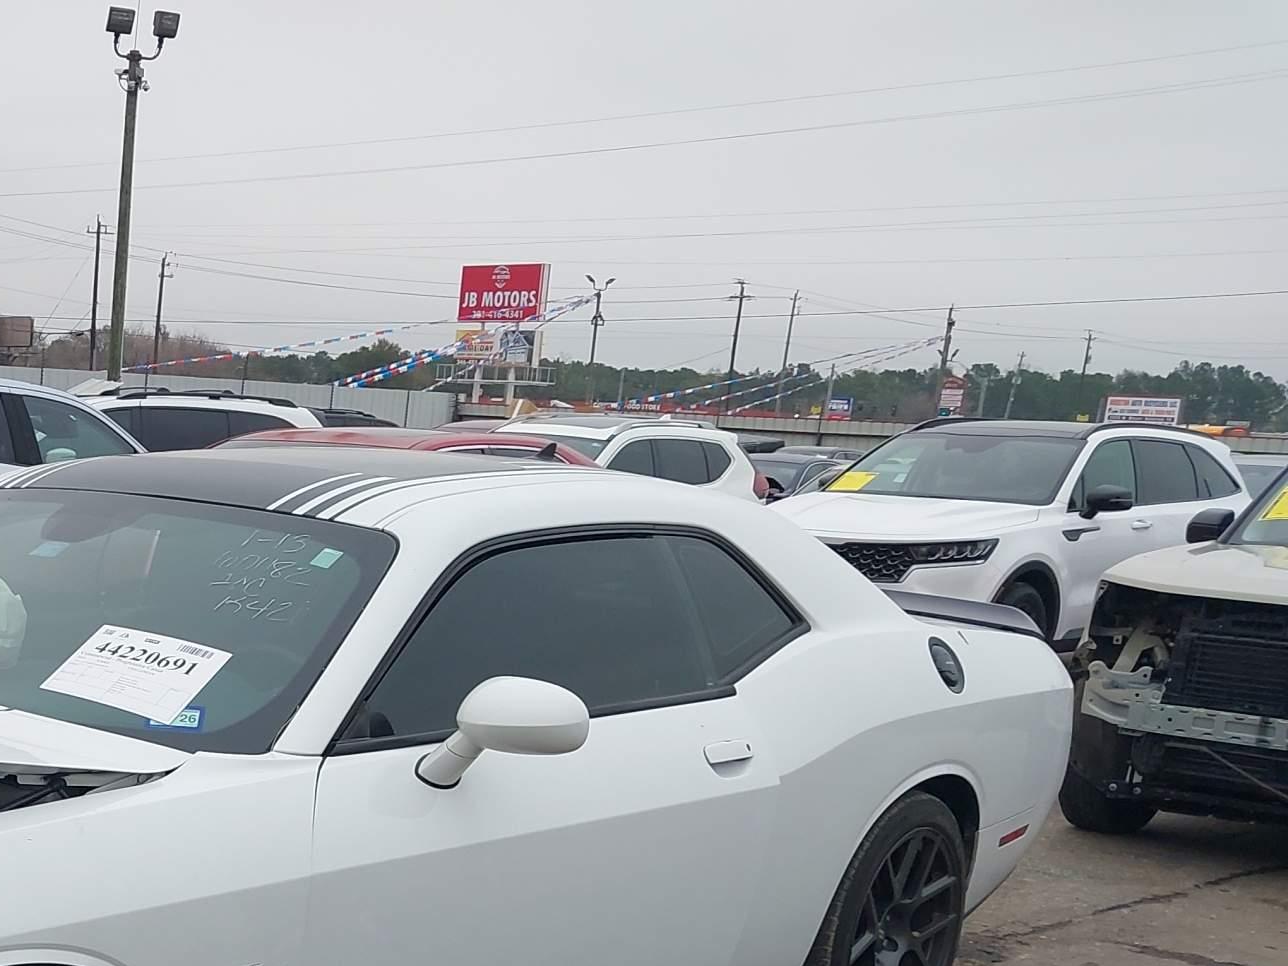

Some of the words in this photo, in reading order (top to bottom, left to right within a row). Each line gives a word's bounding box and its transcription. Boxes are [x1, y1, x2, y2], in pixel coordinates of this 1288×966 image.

[462, 291, 478, 308] JB
[481, 290, 537, 308] MOTORS
[94, 641, 199, 676] 44220691
[179, 713, 198, 724] 26
